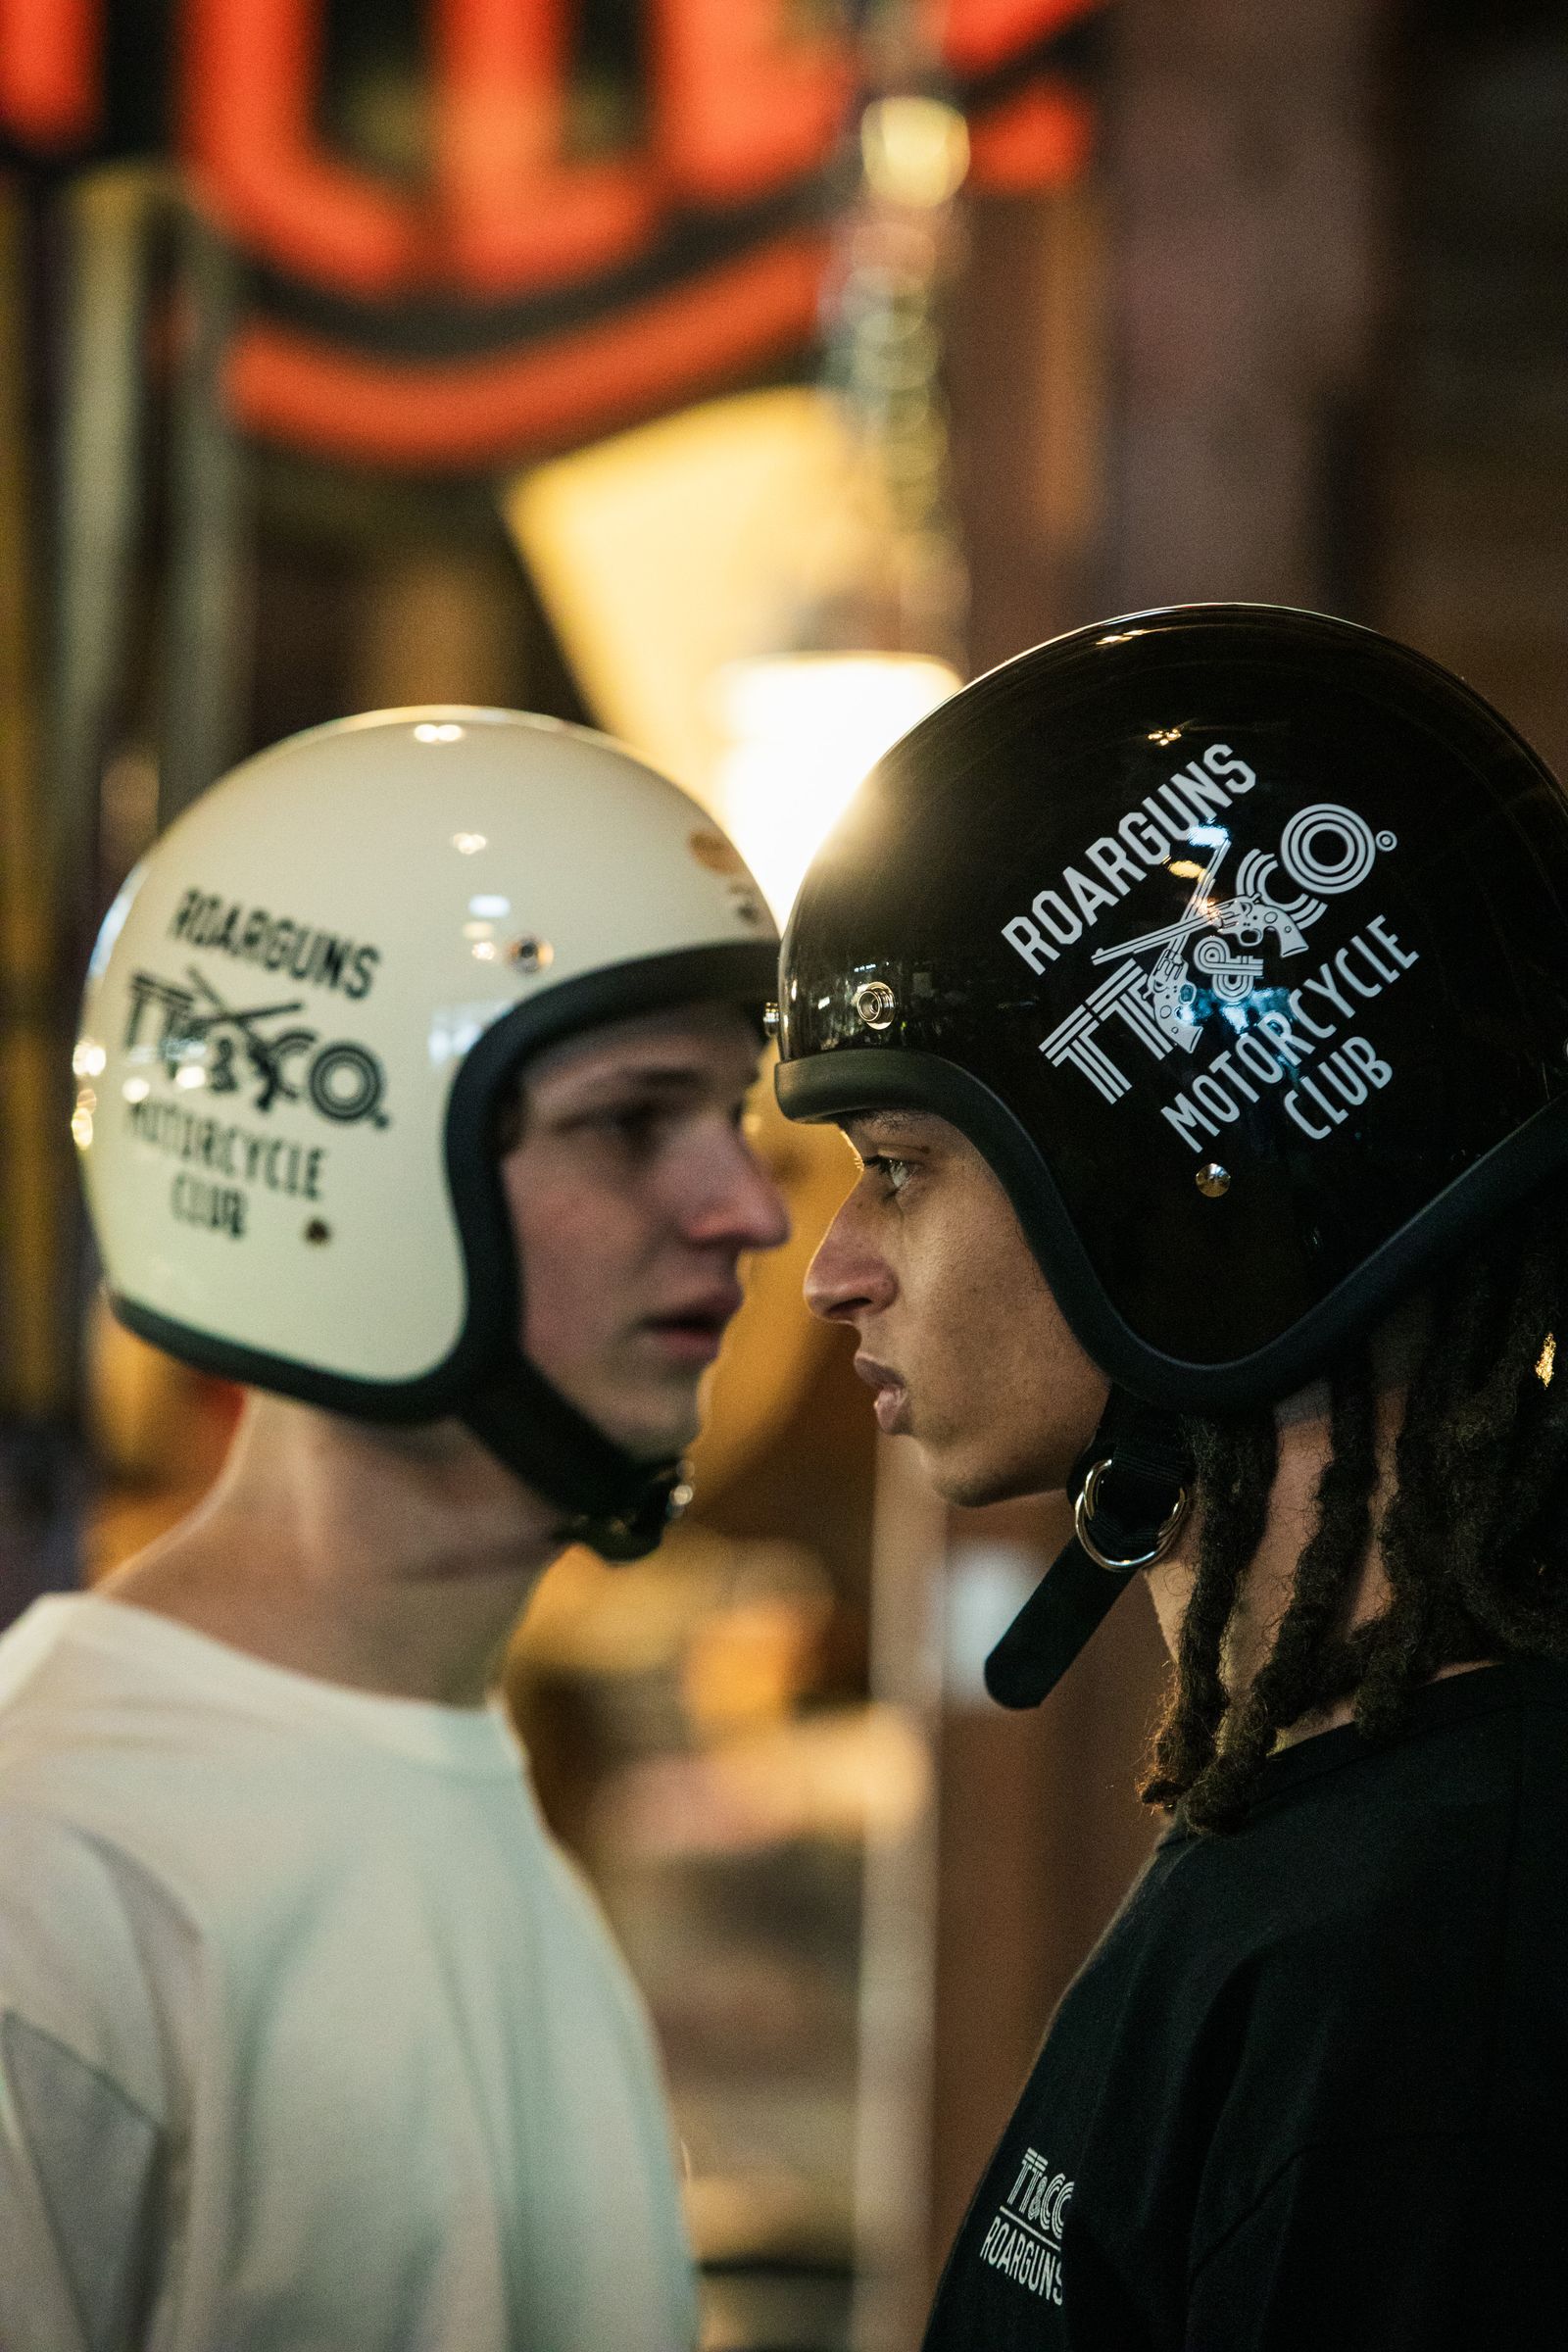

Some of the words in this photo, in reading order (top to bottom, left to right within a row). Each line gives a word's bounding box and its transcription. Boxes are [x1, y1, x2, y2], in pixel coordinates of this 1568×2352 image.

[1001, 744, 1256, 975] ROARGUNS
[1161, 914, 1419, 1153] MOTORCYCLE
[1284, 1036, 1393, 1140] CLUB
[980, 2215, 1062, 2306] ROARGUNS
